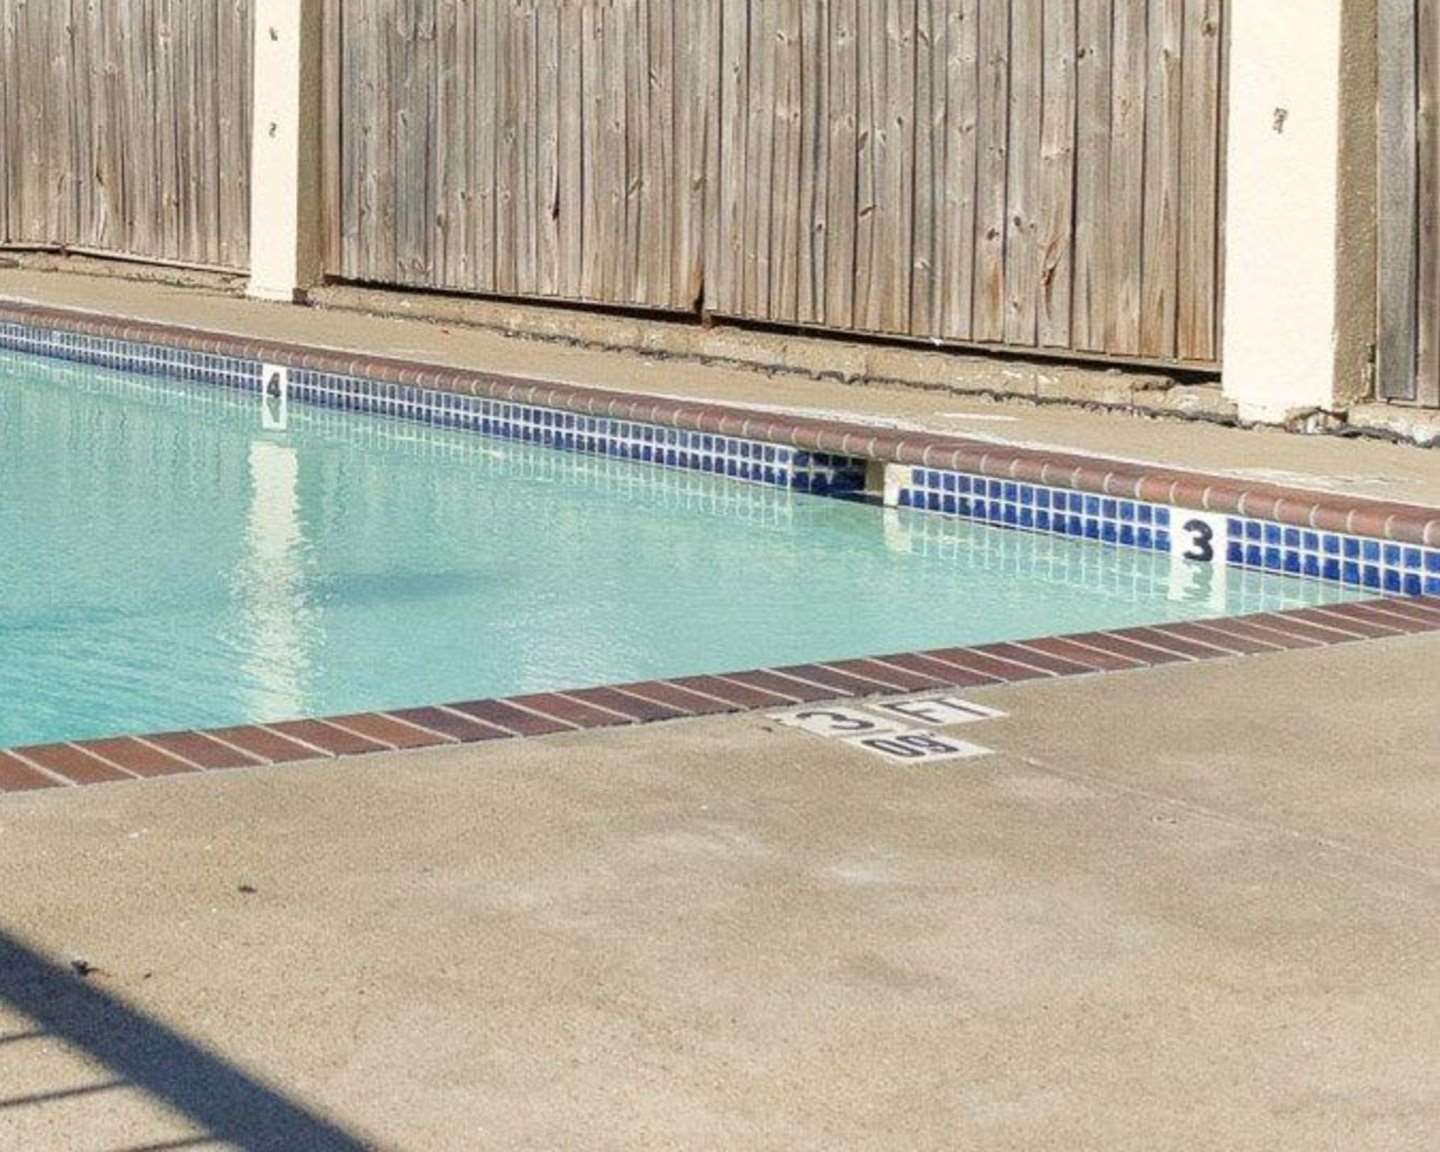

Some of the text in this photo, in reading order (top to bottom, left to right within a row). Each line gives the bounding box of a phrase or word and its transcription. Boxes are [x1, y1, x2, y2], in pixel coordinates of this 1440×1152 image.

[266, 371, 282, 399] 4
[1182, 518, 1214, 562] 3
[795, 697, 992, 730] 3 FT
